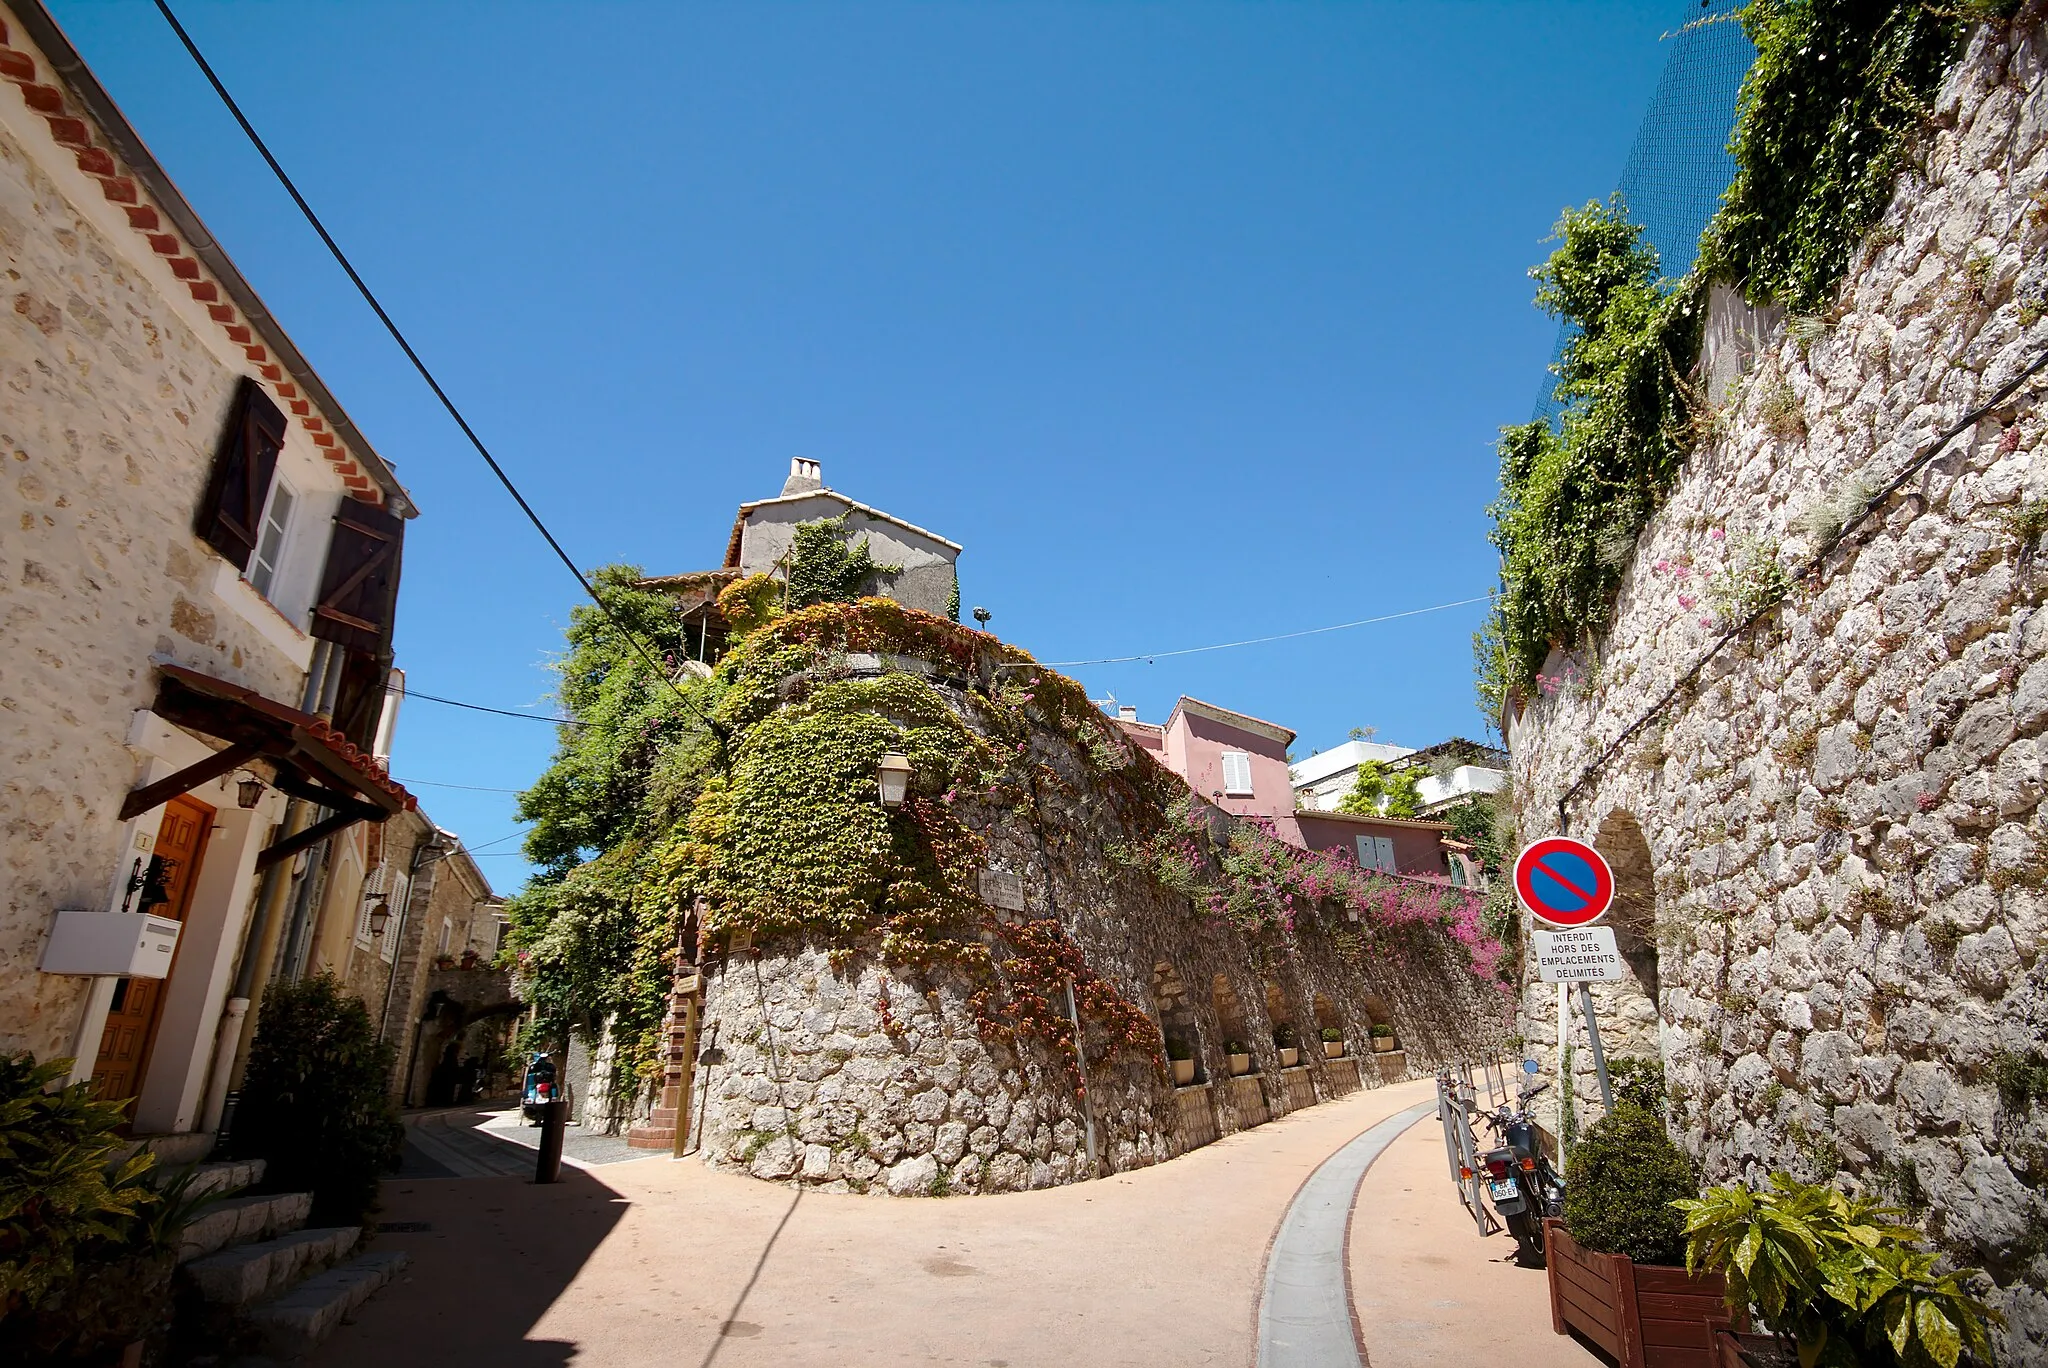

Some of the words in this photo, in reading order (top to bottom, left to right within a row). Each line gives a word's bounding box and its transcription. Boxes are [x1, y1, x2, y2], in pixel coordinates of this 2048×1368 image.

[1552, 932, 1593, 942] INTERDIT
[1551, 944, 1577, 954] HORS
[1581, 943, 1600, 953] DES
[1541, 954, 1616, 966] EMPLACEMENTS
[1556, 966, 1605, 978] DÉLIMITÉS
